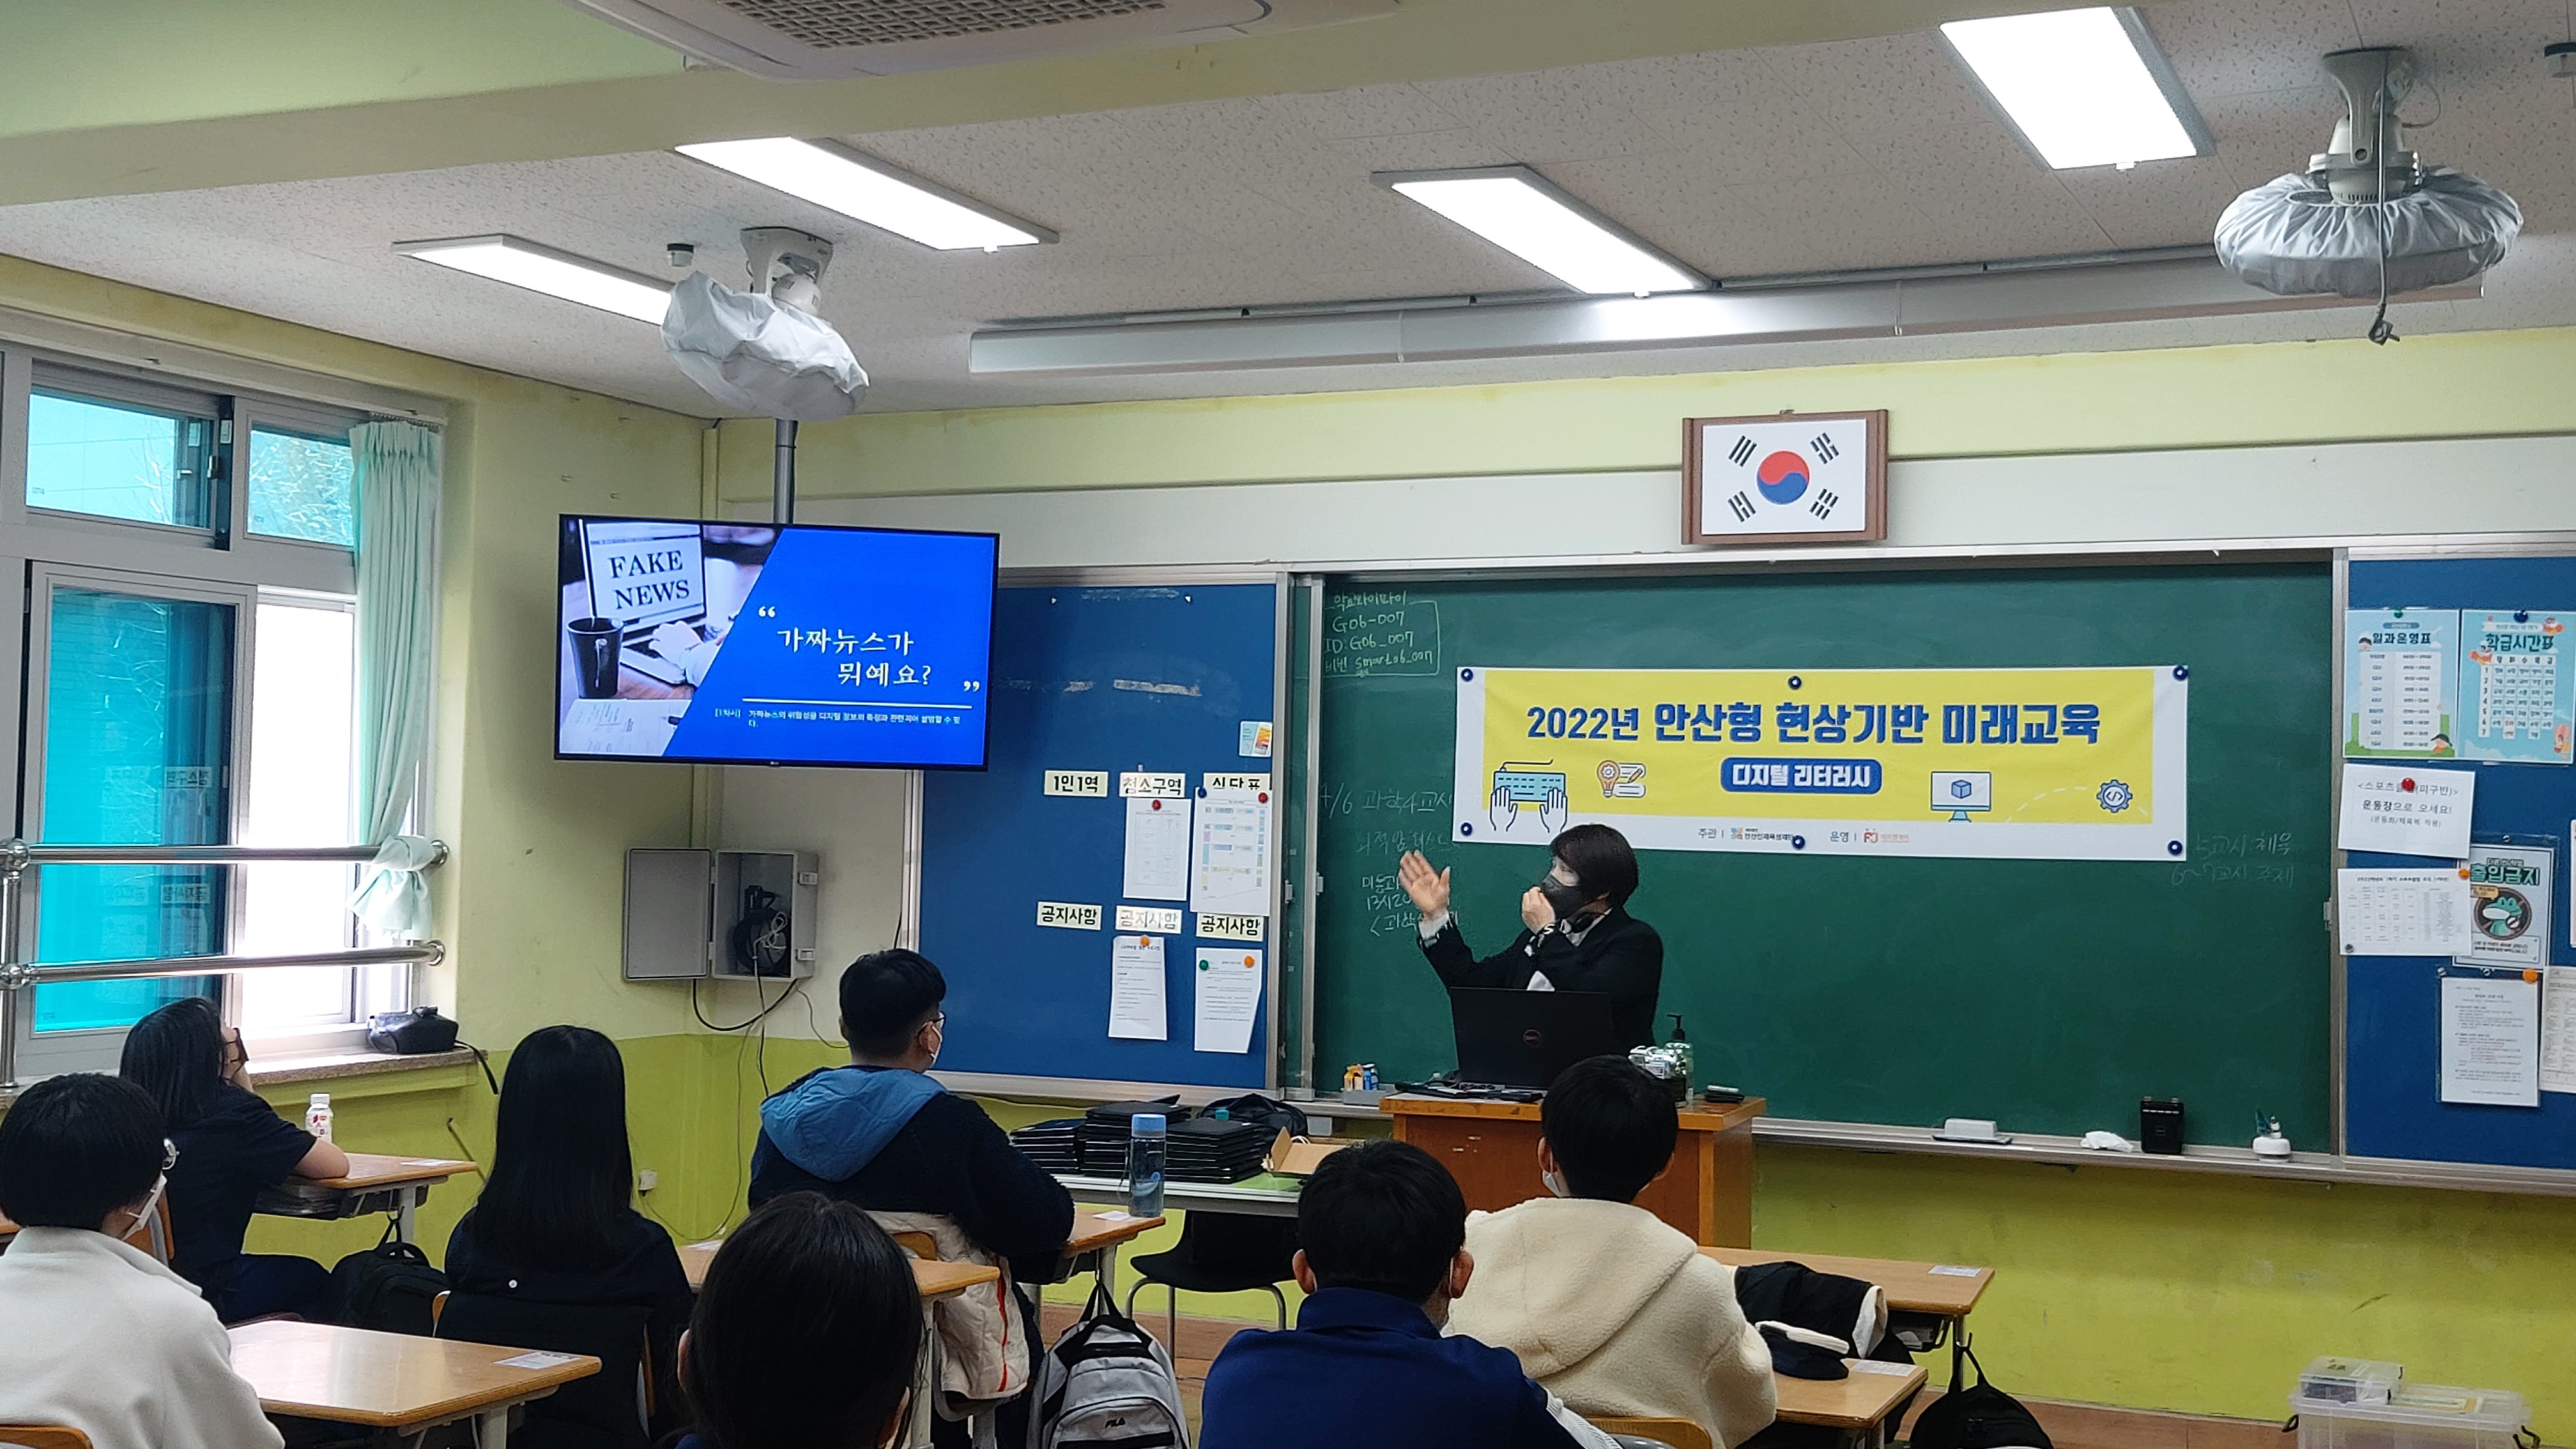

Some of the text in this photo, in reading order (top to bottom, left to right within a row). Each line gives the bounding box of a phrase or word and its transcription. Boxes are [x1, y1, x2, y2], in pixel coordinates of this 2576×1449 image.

[608, 550, 683, 579] FAKE
[614, 579, 690, 610] NEWS
[778, 627, 914, 656] 가짜뉴스가
[2373, 632, 2431, 644] 일과운영표
[2485, 634, 2554, 652] 학급시간표
[838, 662, 931, 687] 뭐예요?
[819, 712, 841, 721] 디지털
[1527, 702, 2101, 745] 2022년 안산형 현상기반 미래교육
[1054, 775, 1099, 793] 1인1역
[1733, 764, 1871, 787] 디지털 리터러시
[1123, 776, 1182, 796] 청소구역
[2363, 799, 2412, 812] 운동장으로
[1698, 828, 1717, 839] 주관
[1829, 831, 1849, 843] 운영
[2471, 863, 2540, 885] 출입금지
[1041, 905, 1098, 925] 공지사항
[1120, 909, 1179, 930] 공지사항
[1201, 915, 1261, 936] 공지사항
